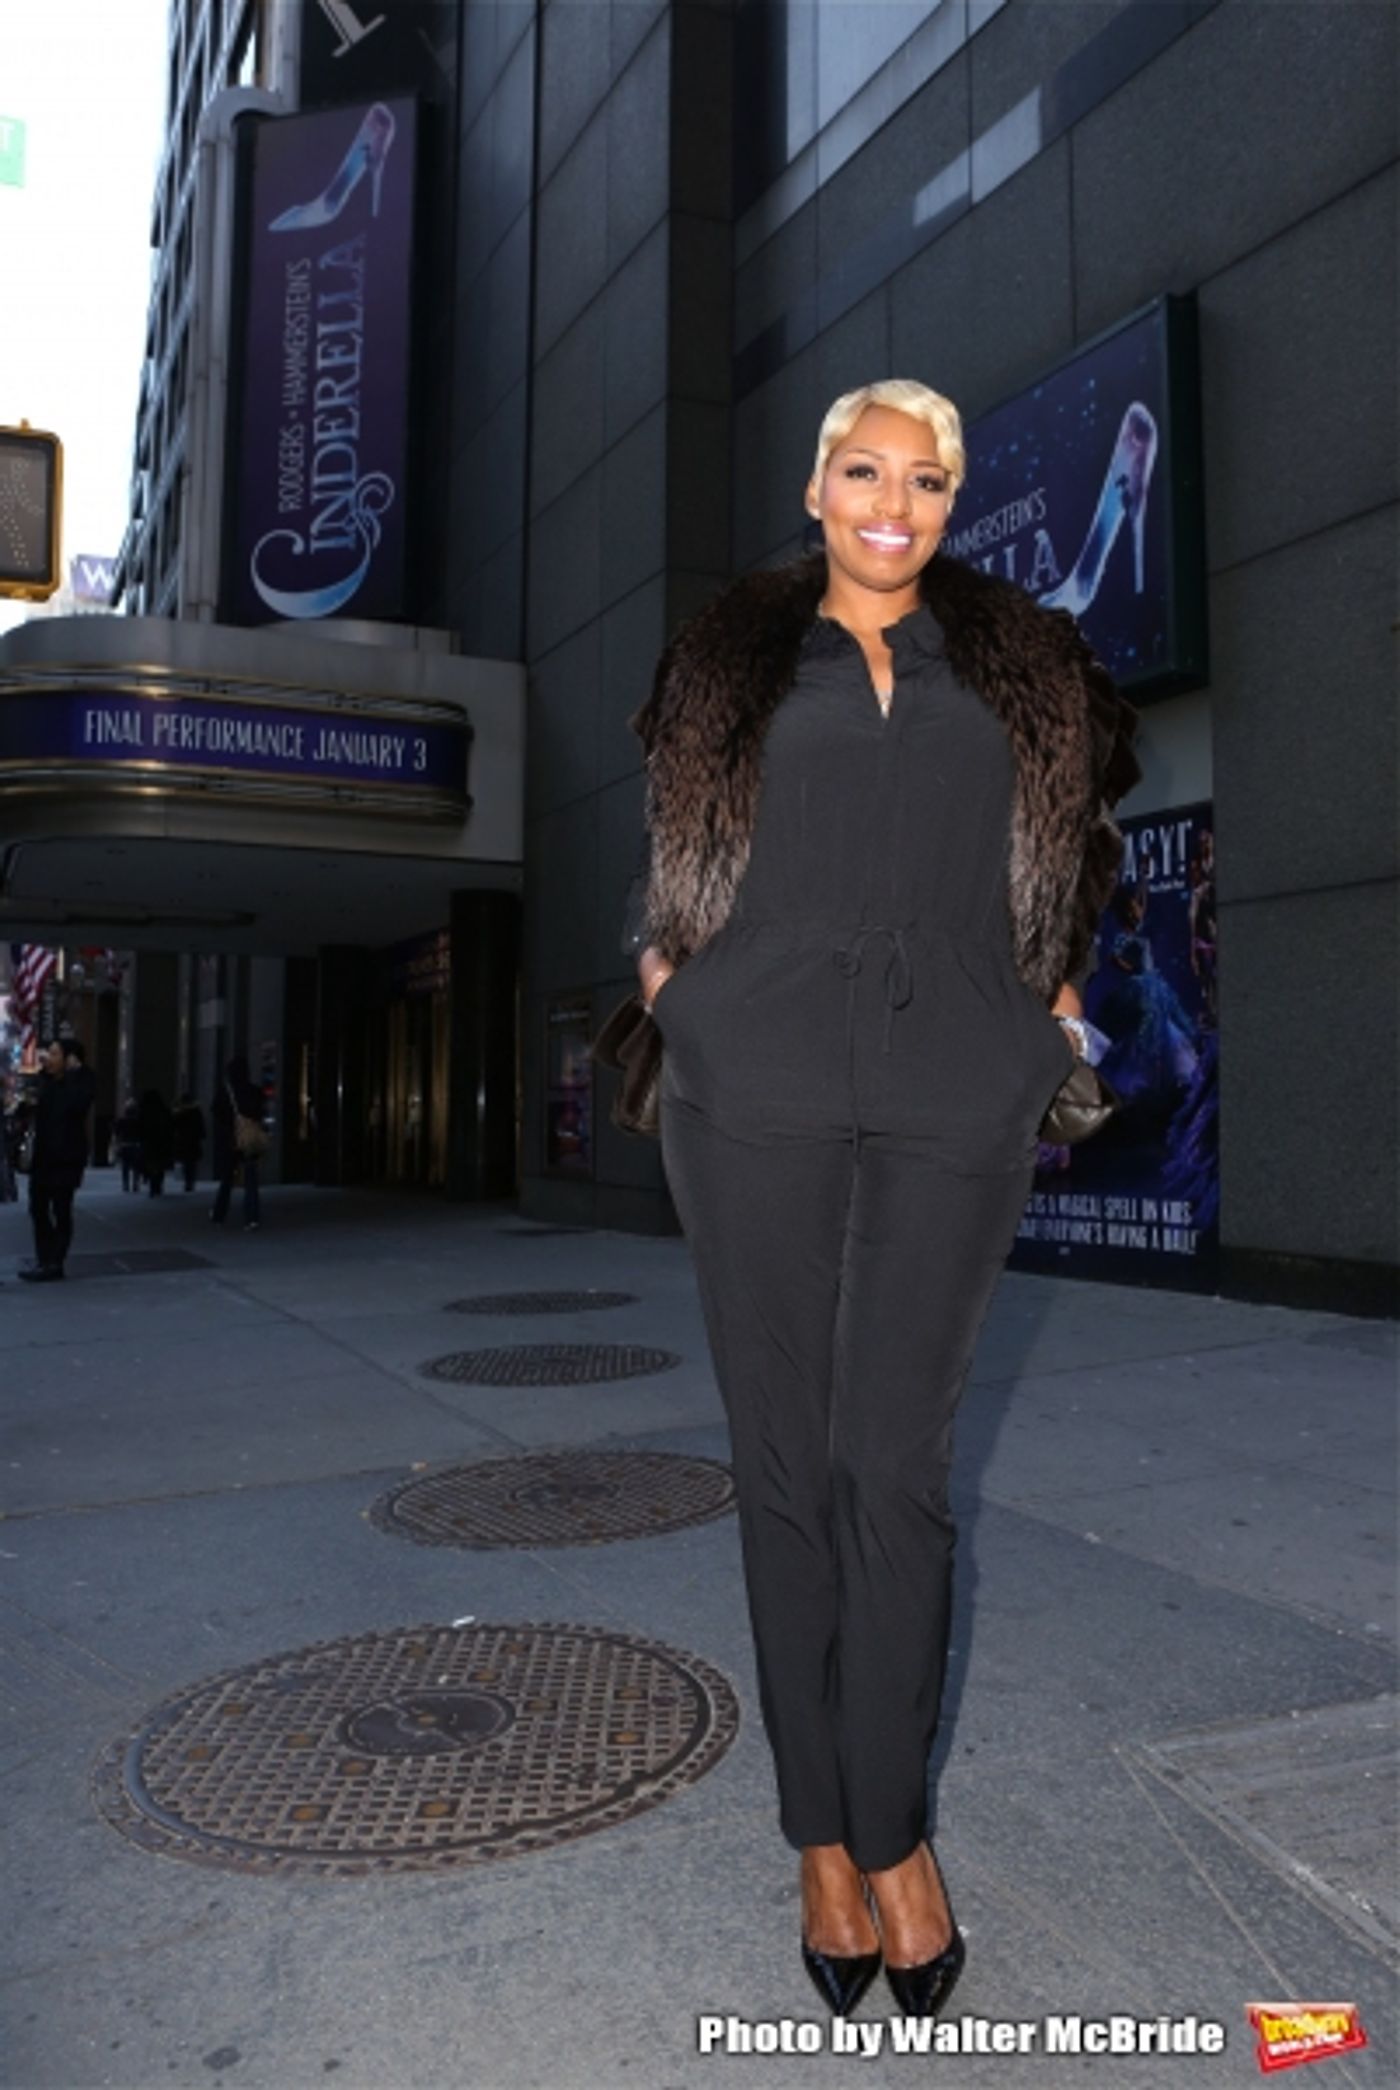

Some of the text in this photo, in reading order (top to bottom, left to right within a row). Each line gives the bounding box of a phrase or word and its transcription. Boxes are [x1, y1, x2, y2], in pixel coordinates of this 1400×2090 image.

[281, 256, 312, 406] HAMMERSTEIN'S
[250, 232, 396, 620] CINDERELLA
[277, 424, 306, 514] RODGERS
[83, 709, 428, 771] FINAL PERFORMANCE JANUARY 3
